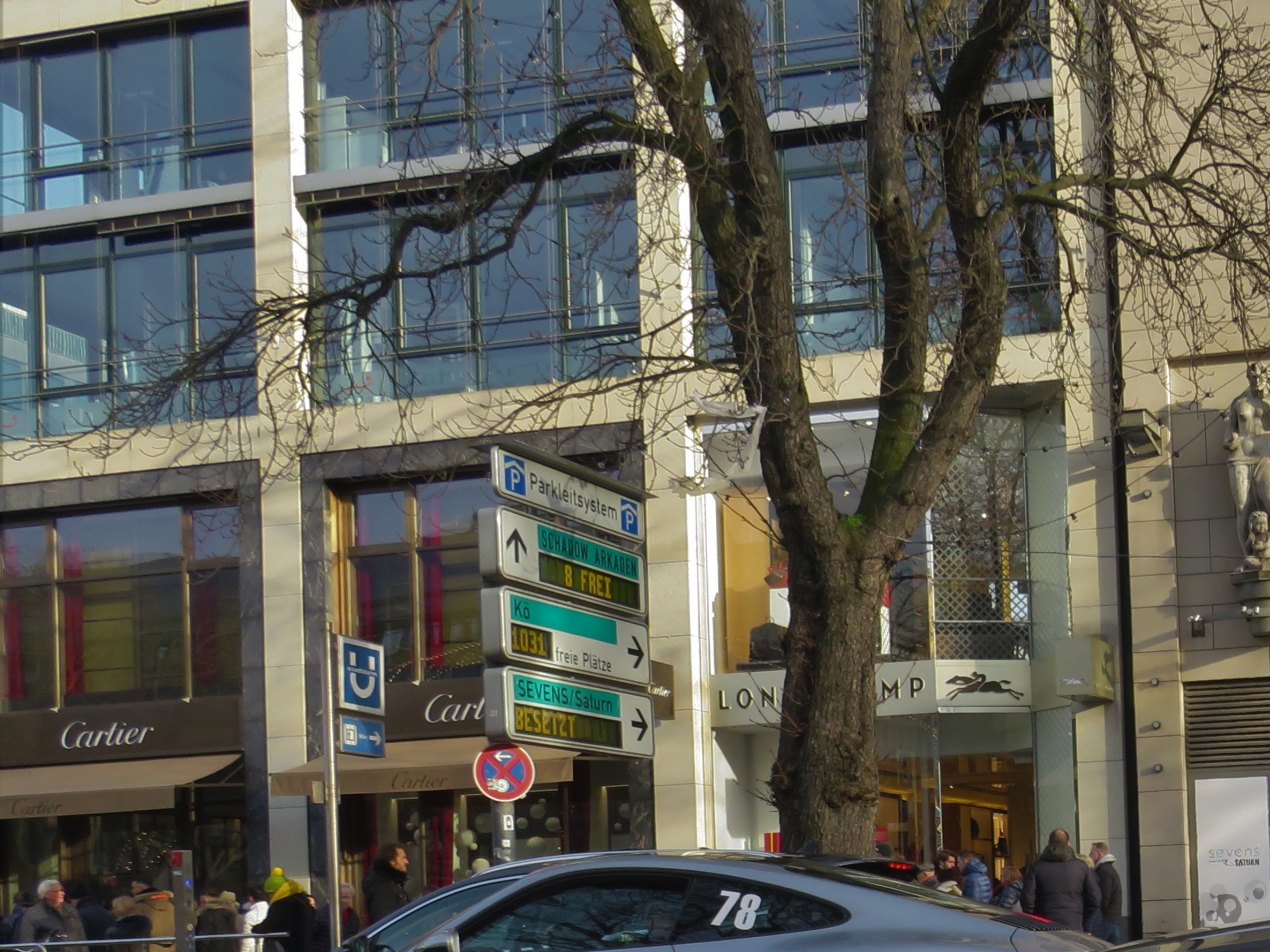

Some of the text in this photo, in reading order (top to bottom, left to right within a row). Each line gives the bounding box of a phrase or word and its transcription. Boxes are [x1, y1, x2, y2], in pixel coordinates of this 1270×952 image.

[529, 472, 618, 520] Parkleitsystem
[541, 529, 637, 577] SCHADOW ARKADEN
[580, 569, 612, 600] FREI
[514, 598, 531, 620] Kö
[511, 626, 612, 673] 1031 freie Plätze
[425, 694, 486, 724] Cart
[518, 679, 613, 713] SEVENS/Saturn
[61, 721, 155, 750] Cartier
[515, 706, 577, 738] BESETZT
[391, 771, 449, 790] Cartier
[11, 800, 63, 816] Cartier
[1208, 847, 1260, 859] sevens
[1235, 859, 1260, 867] SATURN
[710, 890, 762, 931] 78
